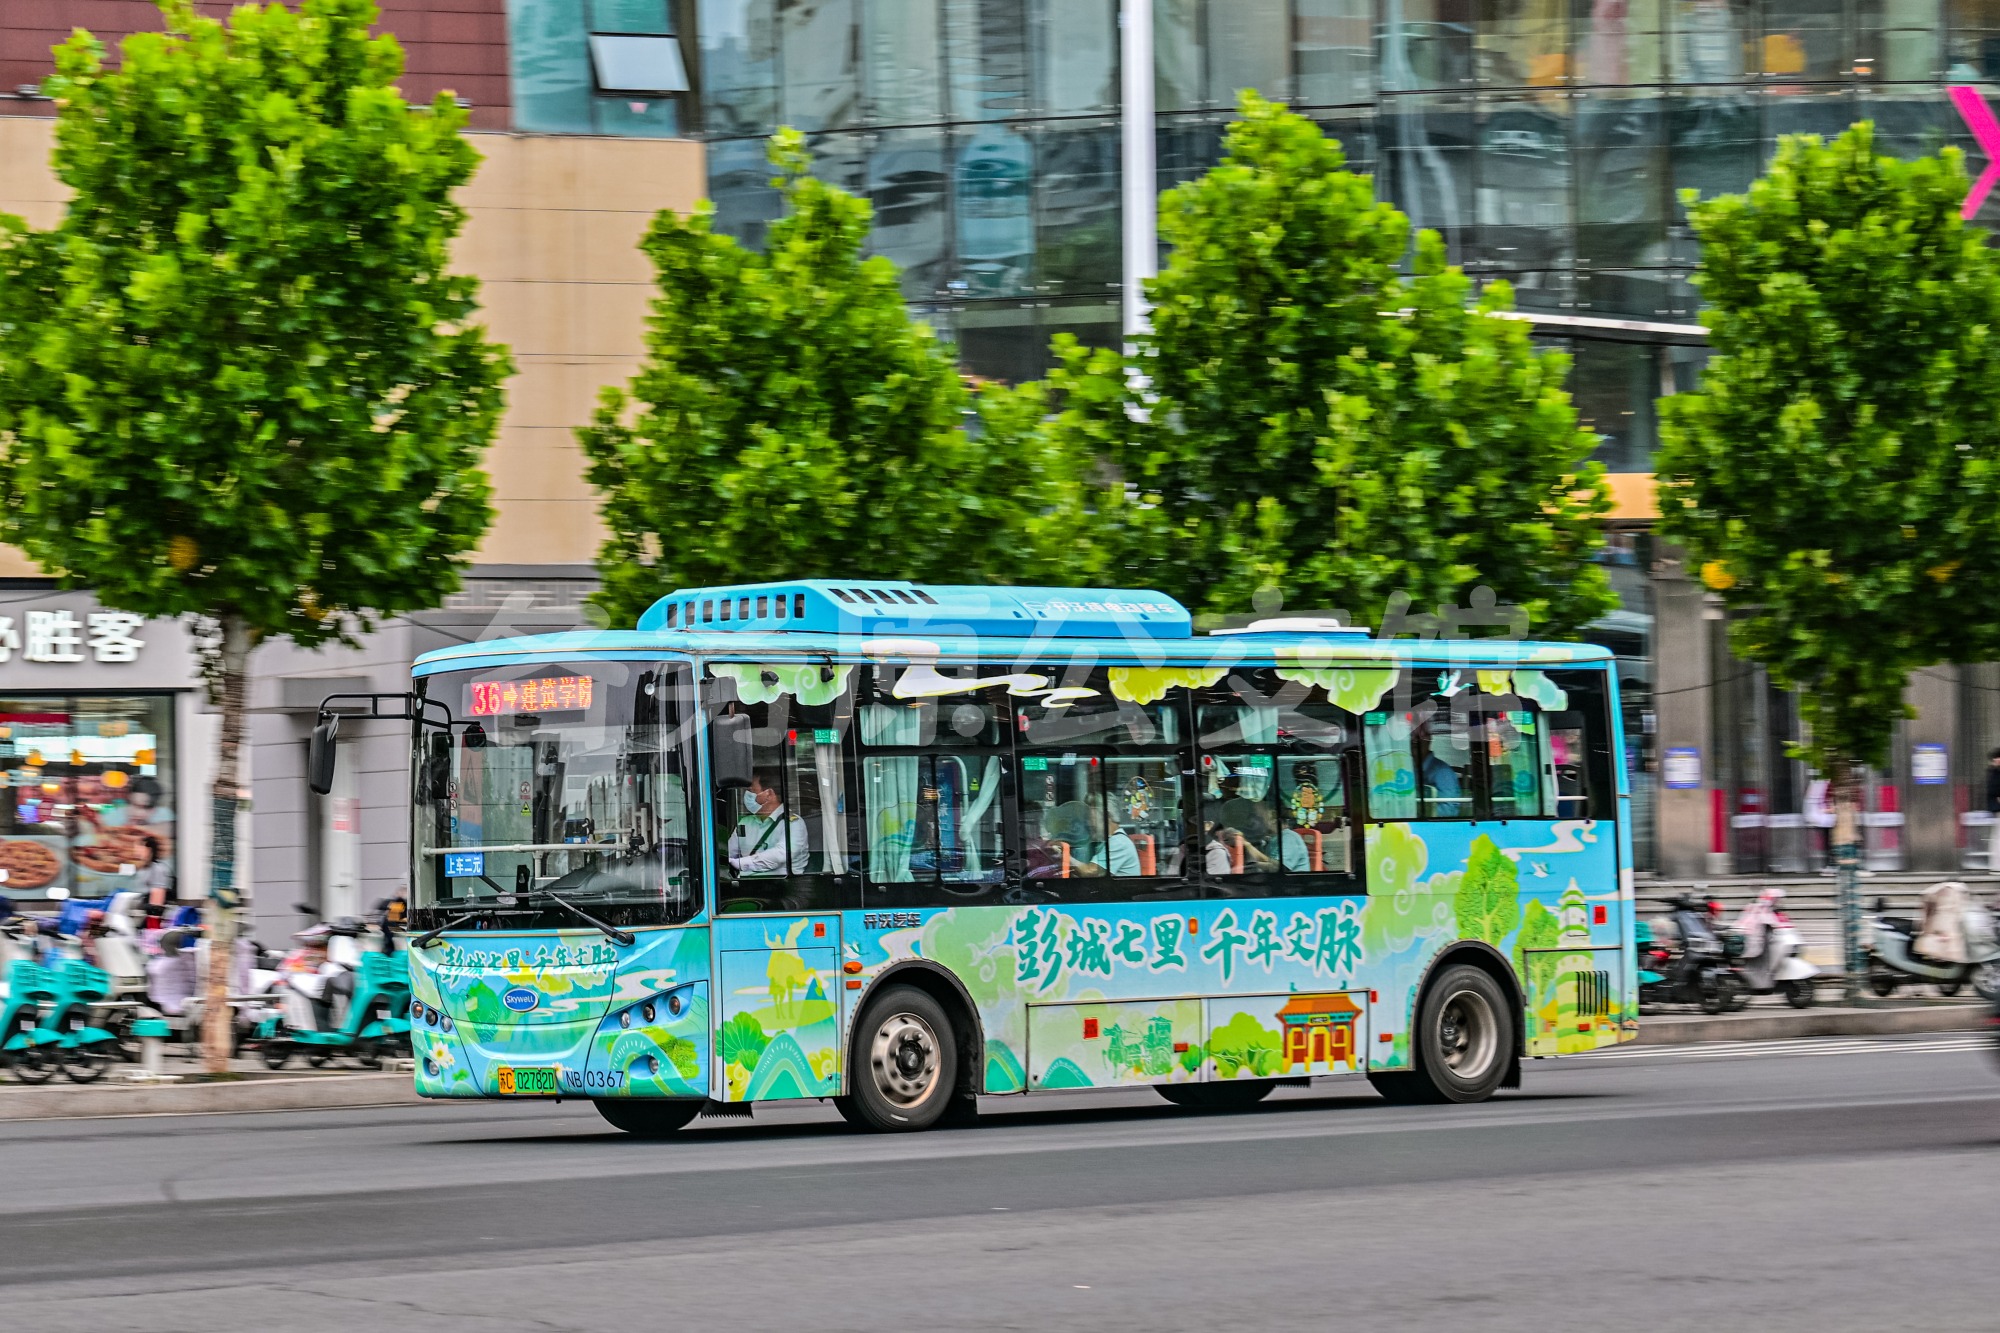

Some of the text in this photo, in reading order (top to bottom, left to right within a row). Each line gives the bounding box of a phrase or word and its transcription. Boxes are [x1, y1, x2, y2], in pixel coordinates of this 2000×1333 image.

[474, 682, 501, 715] 36
[447, 857, 481, 875] 上车二元
[863, 911, 922, 930] 开沃汽车
[1015, 903, 1363, 992] 彭城七里 千年文脉
[443, 943, 616, 986] 彭城七里 千年文脉
[506, 995, 534, 1004] Skywell
